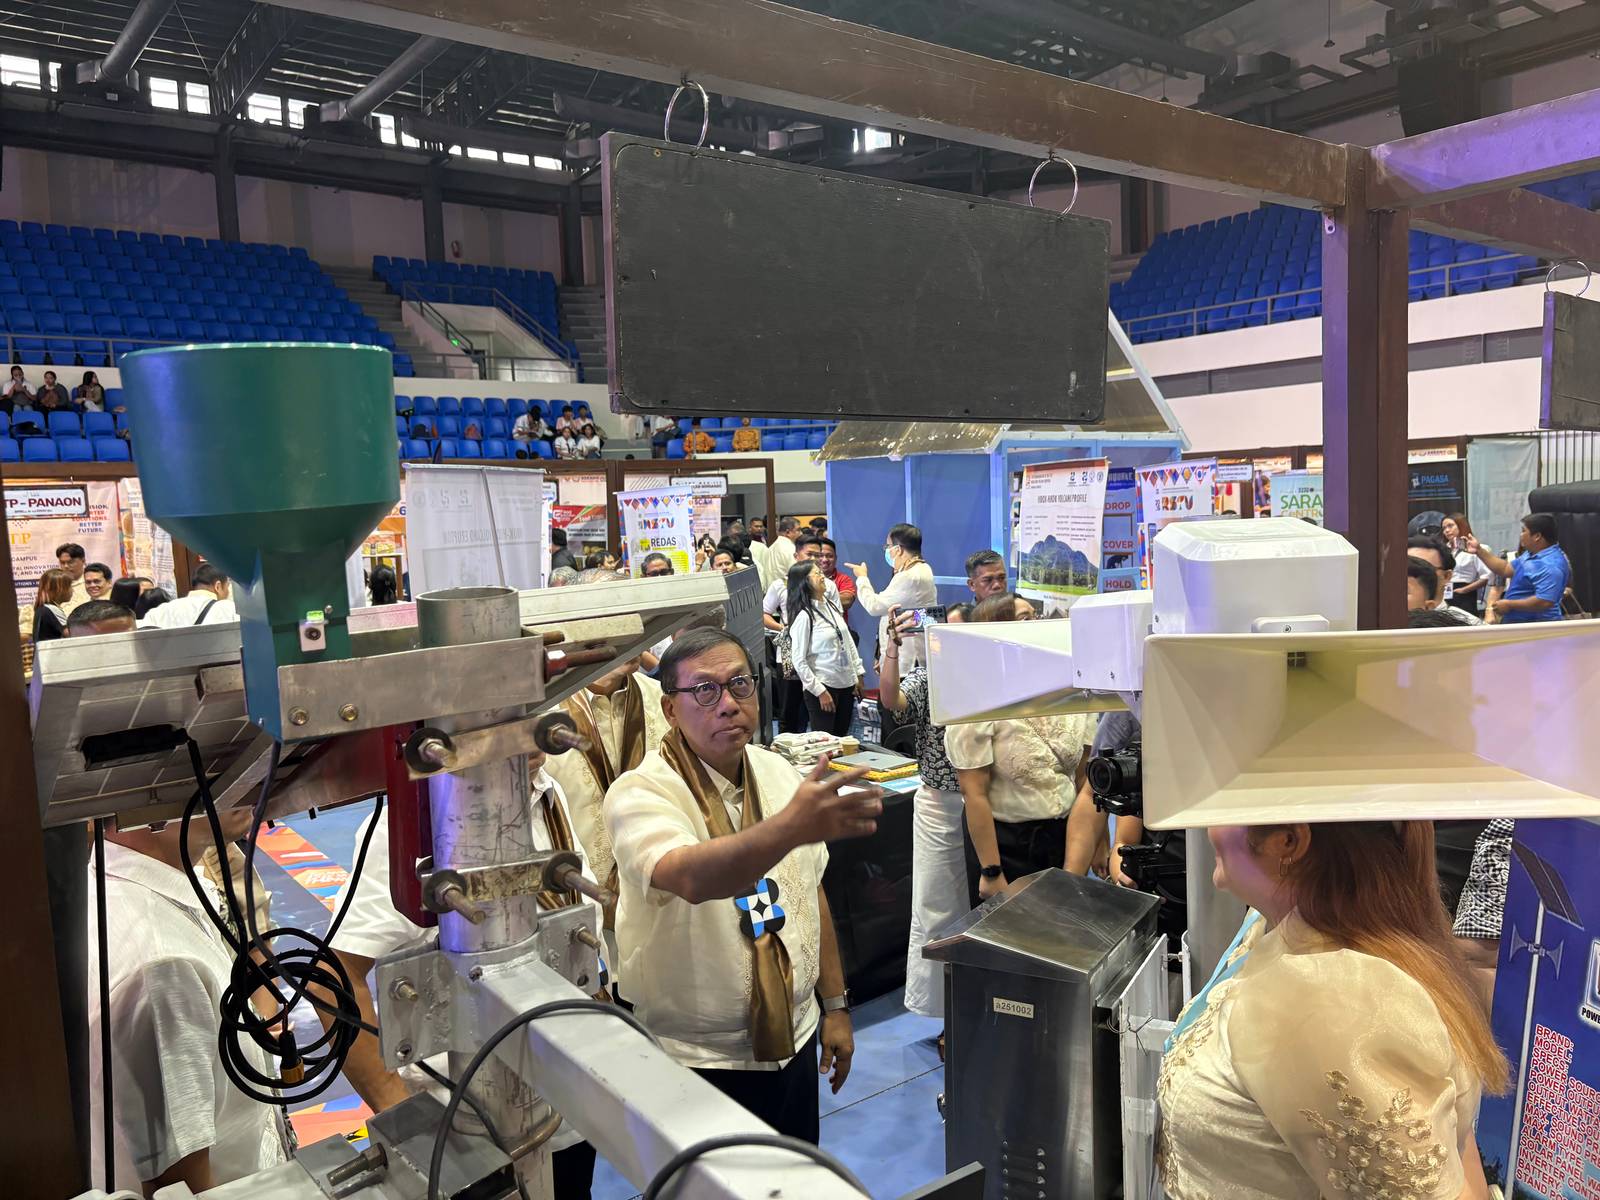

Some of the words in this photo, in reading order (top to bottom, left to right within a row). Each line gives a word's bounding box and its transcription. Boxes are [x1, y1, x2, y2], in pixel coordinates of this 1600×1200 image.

[28, 496, 82, 508] PANAON
[1104, 502, 1131, 510] DROP
[650, 536, 677, 547] REDAS
[1102, 541, 1134, 549] COVER
[1105, 579, 1132, 589] HOLD
[1534, 1035, 1573, 1063] MODEL:
[1536, 1024, 1574, 1052] BRAND:
[1531, 1058, 1567, 1084] POWER
[1533, 1047, 1569, 1073] SPECS:
[1528, 1080, 1567, 1108] OUTPUT
[1529, 1069, 1566, 1096] POWER
[1526, 1091, 1578, 1128] EFFECTIVE
[1521, 1125, 1556, 1152] ALARM
[1549, 1128, 1582, 1155] SOUND
[1551, 1116, 1584, 1144] SOUND
[1519, 1147, 1565, 1181] INVERTER
[1520, 1136, 1553, 1162] SOLAR
[1555, 1156, 1585, 1183] PANEL
[1516, 1168, 1548, 1195] STAND
